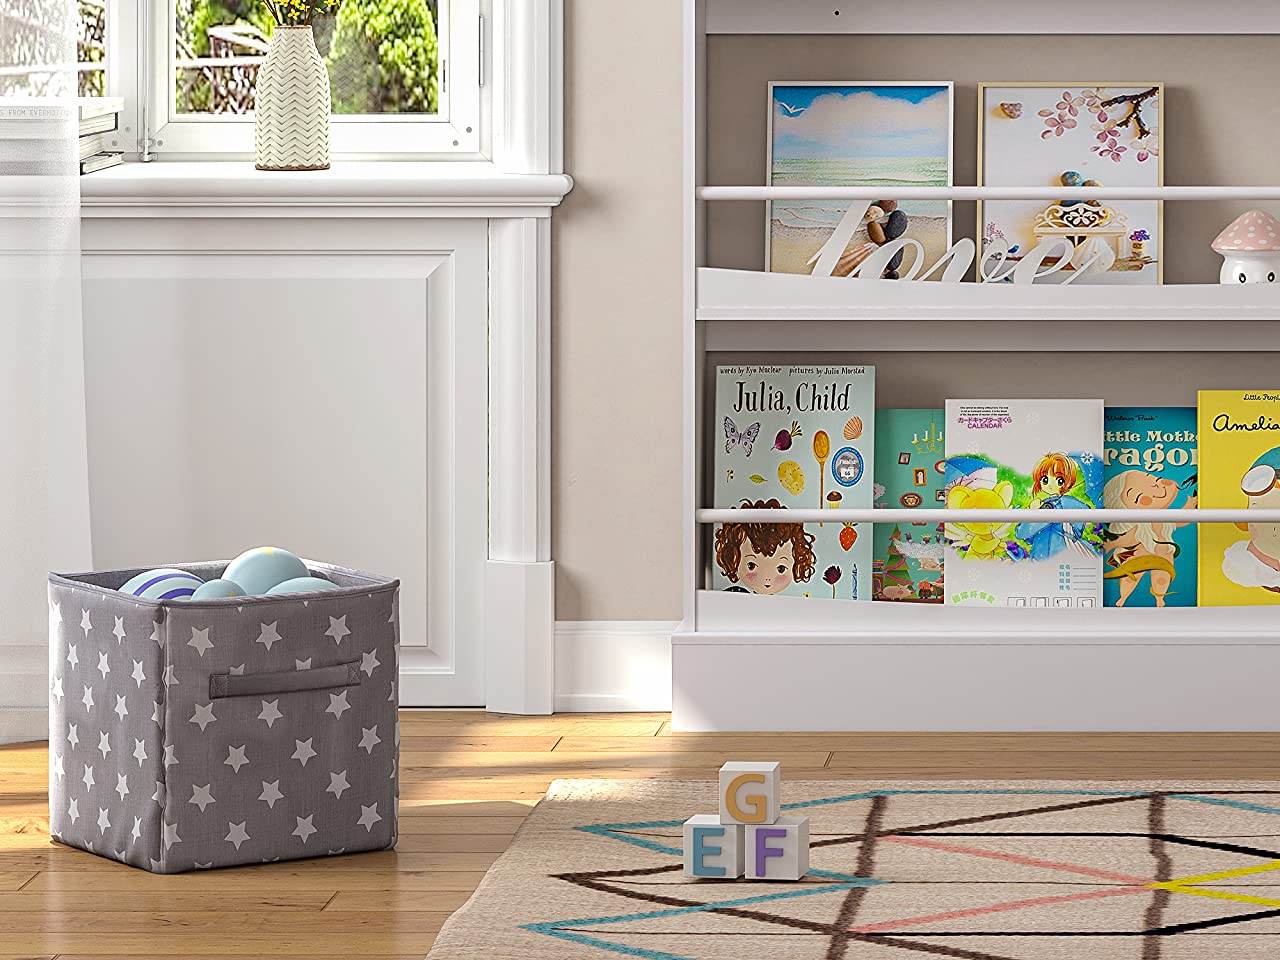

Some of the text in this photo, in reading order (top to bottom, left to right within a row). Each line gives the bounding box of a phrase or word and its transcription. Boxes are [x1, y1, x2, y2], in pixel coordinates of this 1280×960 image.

[789, 366, 814, 376] pictures
[732, 381, 852, 414] Julia, Child
[1243, 393, 1262, 401] Little
[1104, 430, 1198, 442] ttle Moth
[1104, 443, 1198, 471] rago
[725, 773, 767, 823] G
[693, 827, 726, 877] E
[755, 828, 787, 877] F
